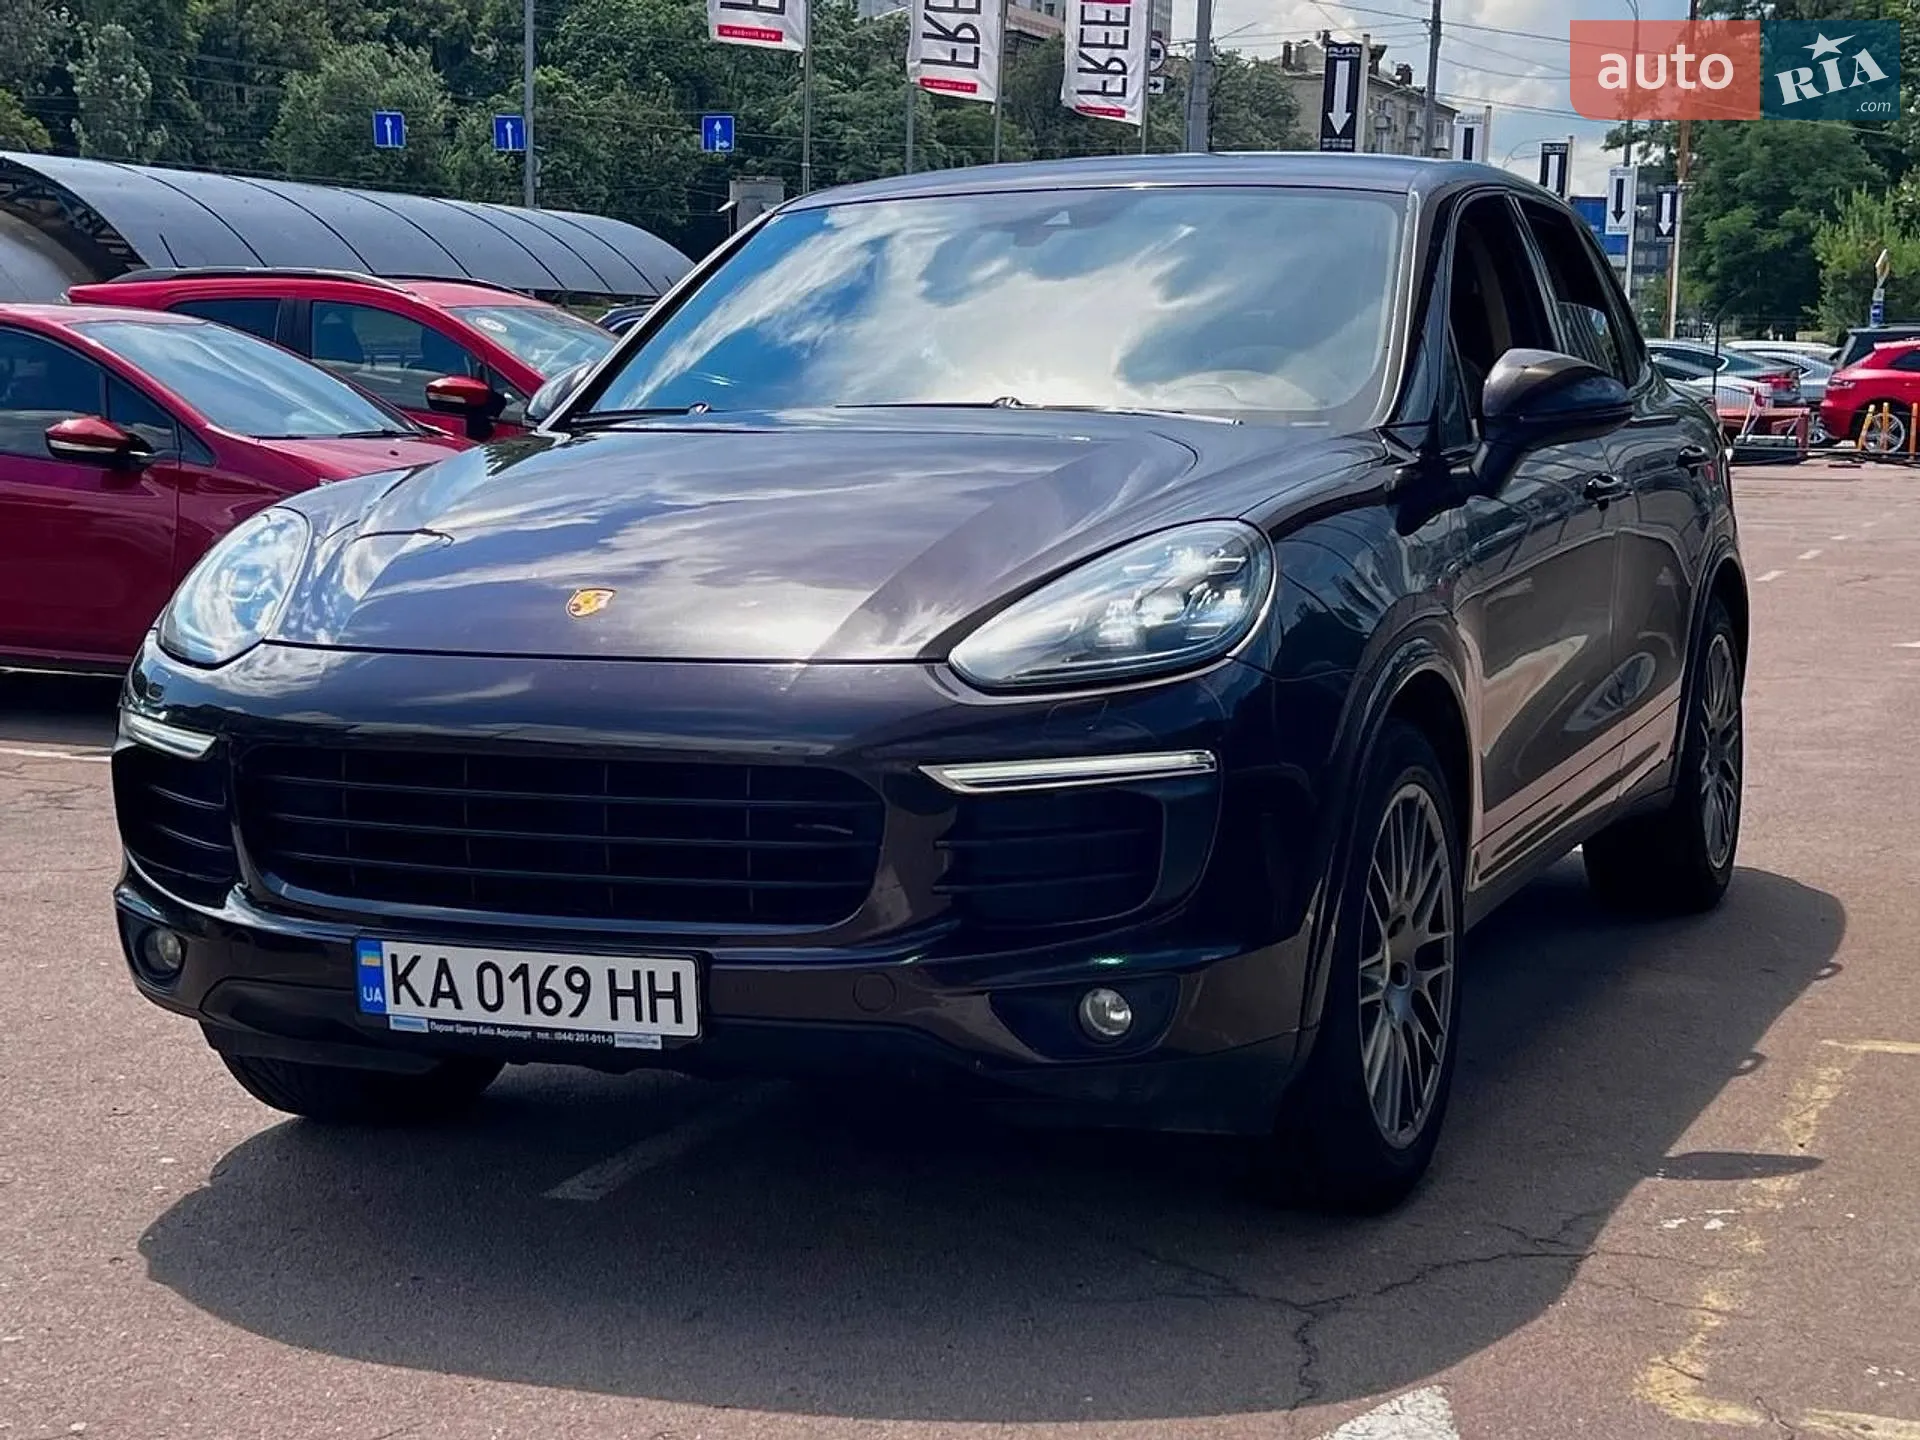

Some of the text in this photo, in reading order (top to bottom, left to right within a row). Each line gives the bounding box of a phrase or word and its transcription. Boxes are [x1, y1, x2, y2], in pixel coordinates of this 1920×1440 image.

[362, 985, 384, 1003] UA
[390, 953, 683, 1024] KA 0169 HH
